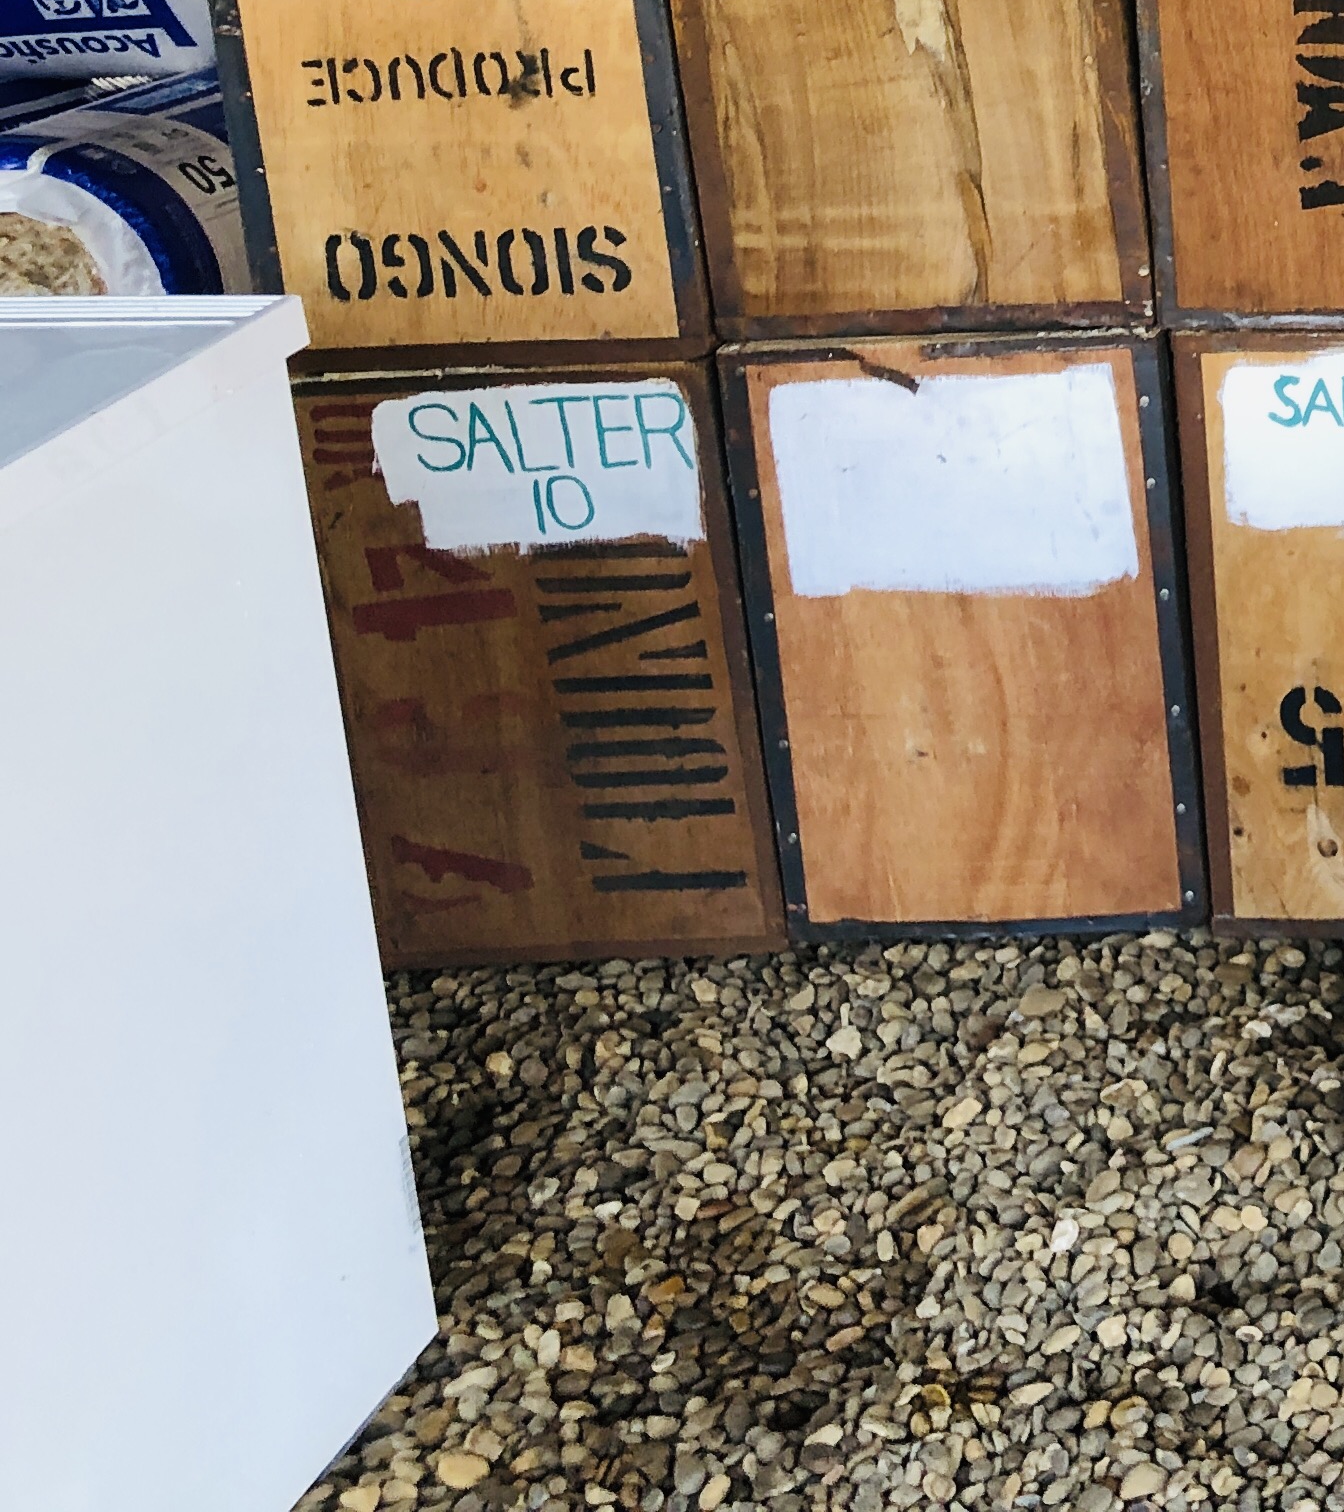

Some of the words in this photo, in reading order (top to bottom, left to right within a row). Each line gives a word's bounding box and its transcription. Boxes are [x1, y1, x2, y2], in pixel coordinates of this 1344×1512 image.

[300, 44, 598, 108] PRODUCE
[179, 154, 236, 195] 50
[323, 223, 634, 305] SIONGO
[408, 391, 695, 474] SALTER
[532, 474, 596, 535] 10
